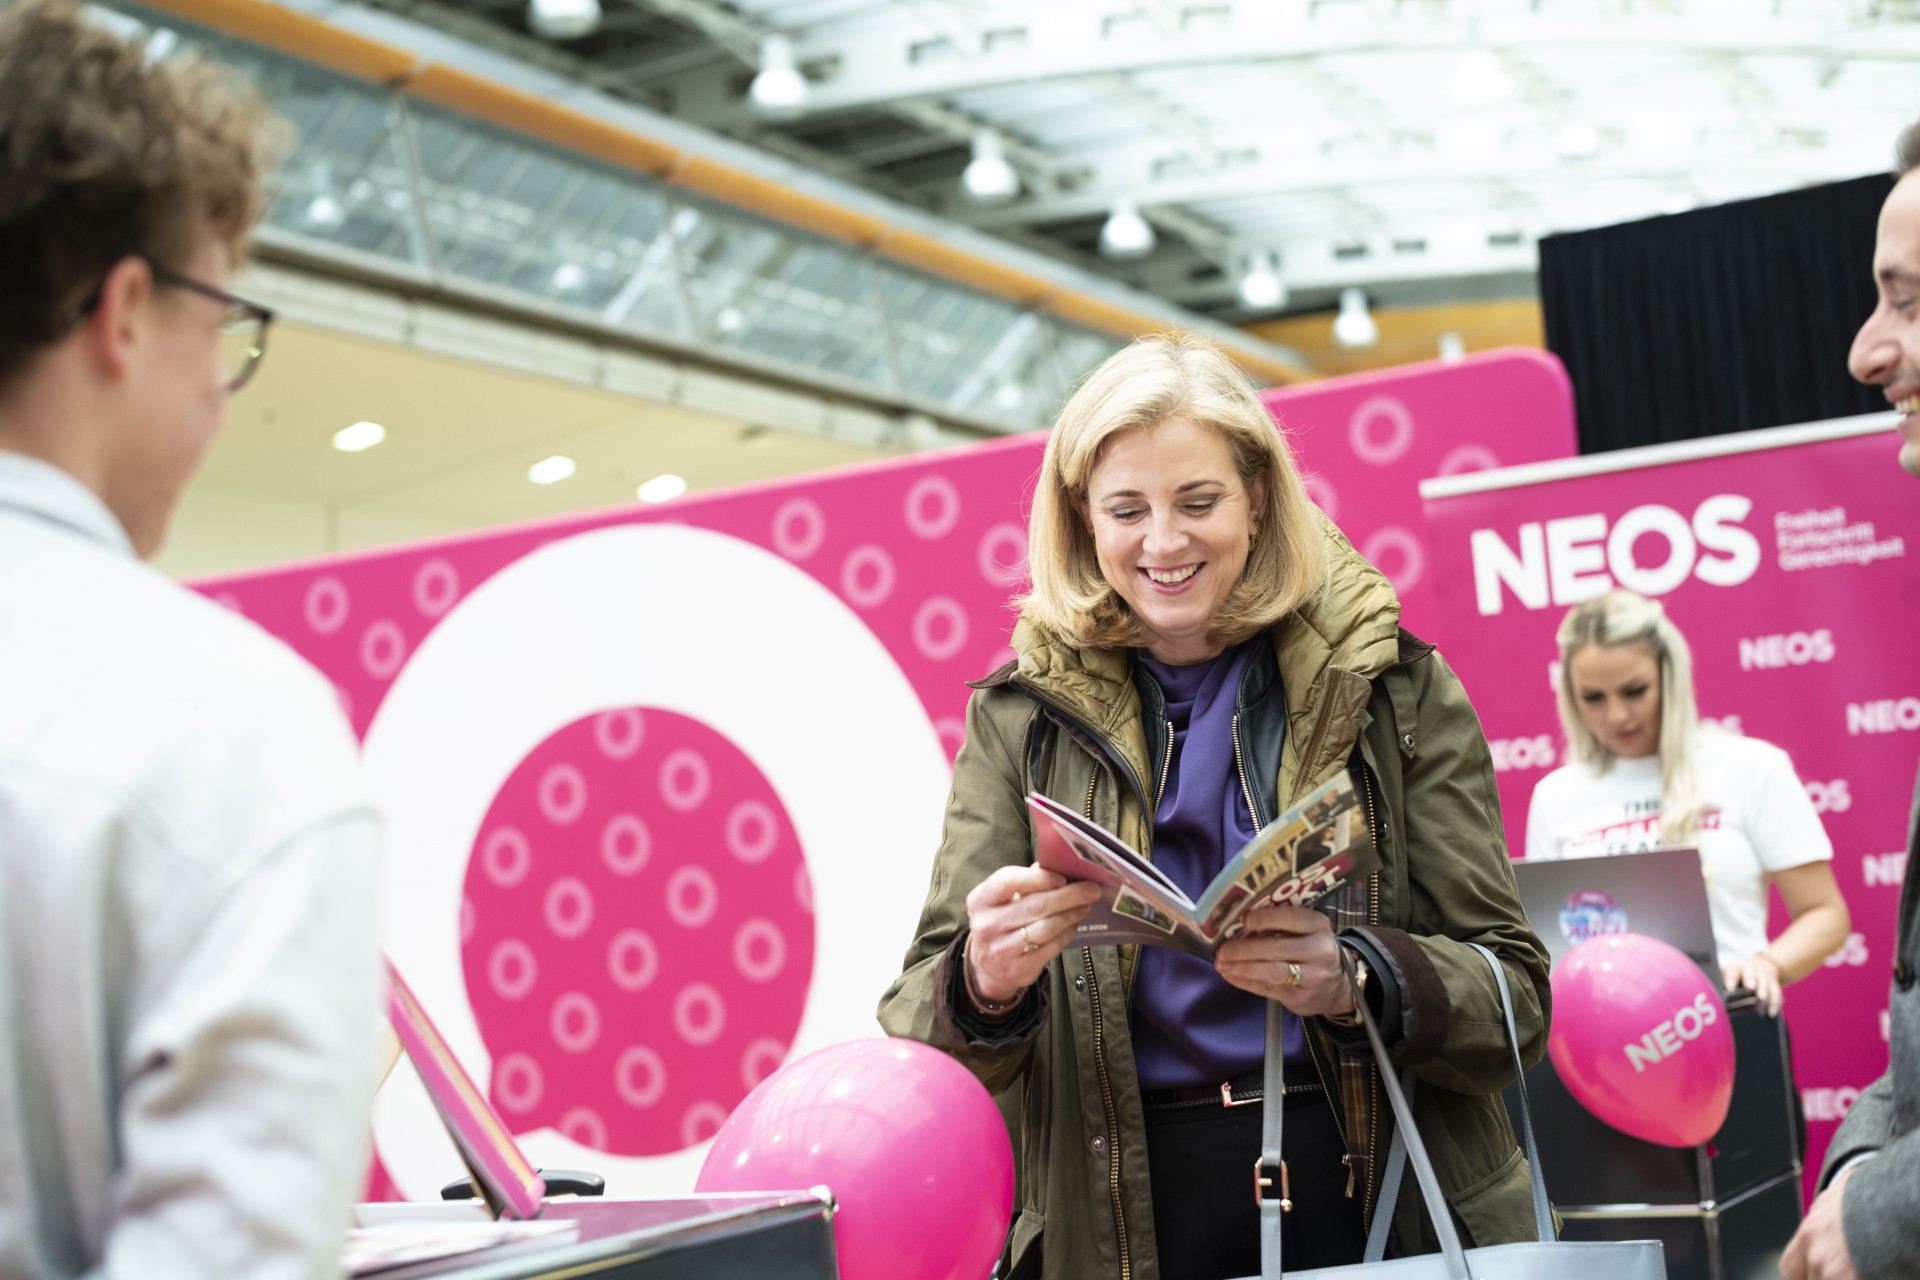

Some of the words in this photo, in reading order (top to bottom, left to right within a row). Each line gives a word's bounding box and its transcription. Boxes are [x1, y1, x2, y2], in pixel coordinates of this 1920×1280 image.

[1470, 494, 1760, 616] NEOS
[1738, 629, 1836, 671] NEOS
[1846, 696, 1920, 736] NEO
[1489, 734, 1556, 772] EOS
[1623, 992, 1717, 1073] NEOS
